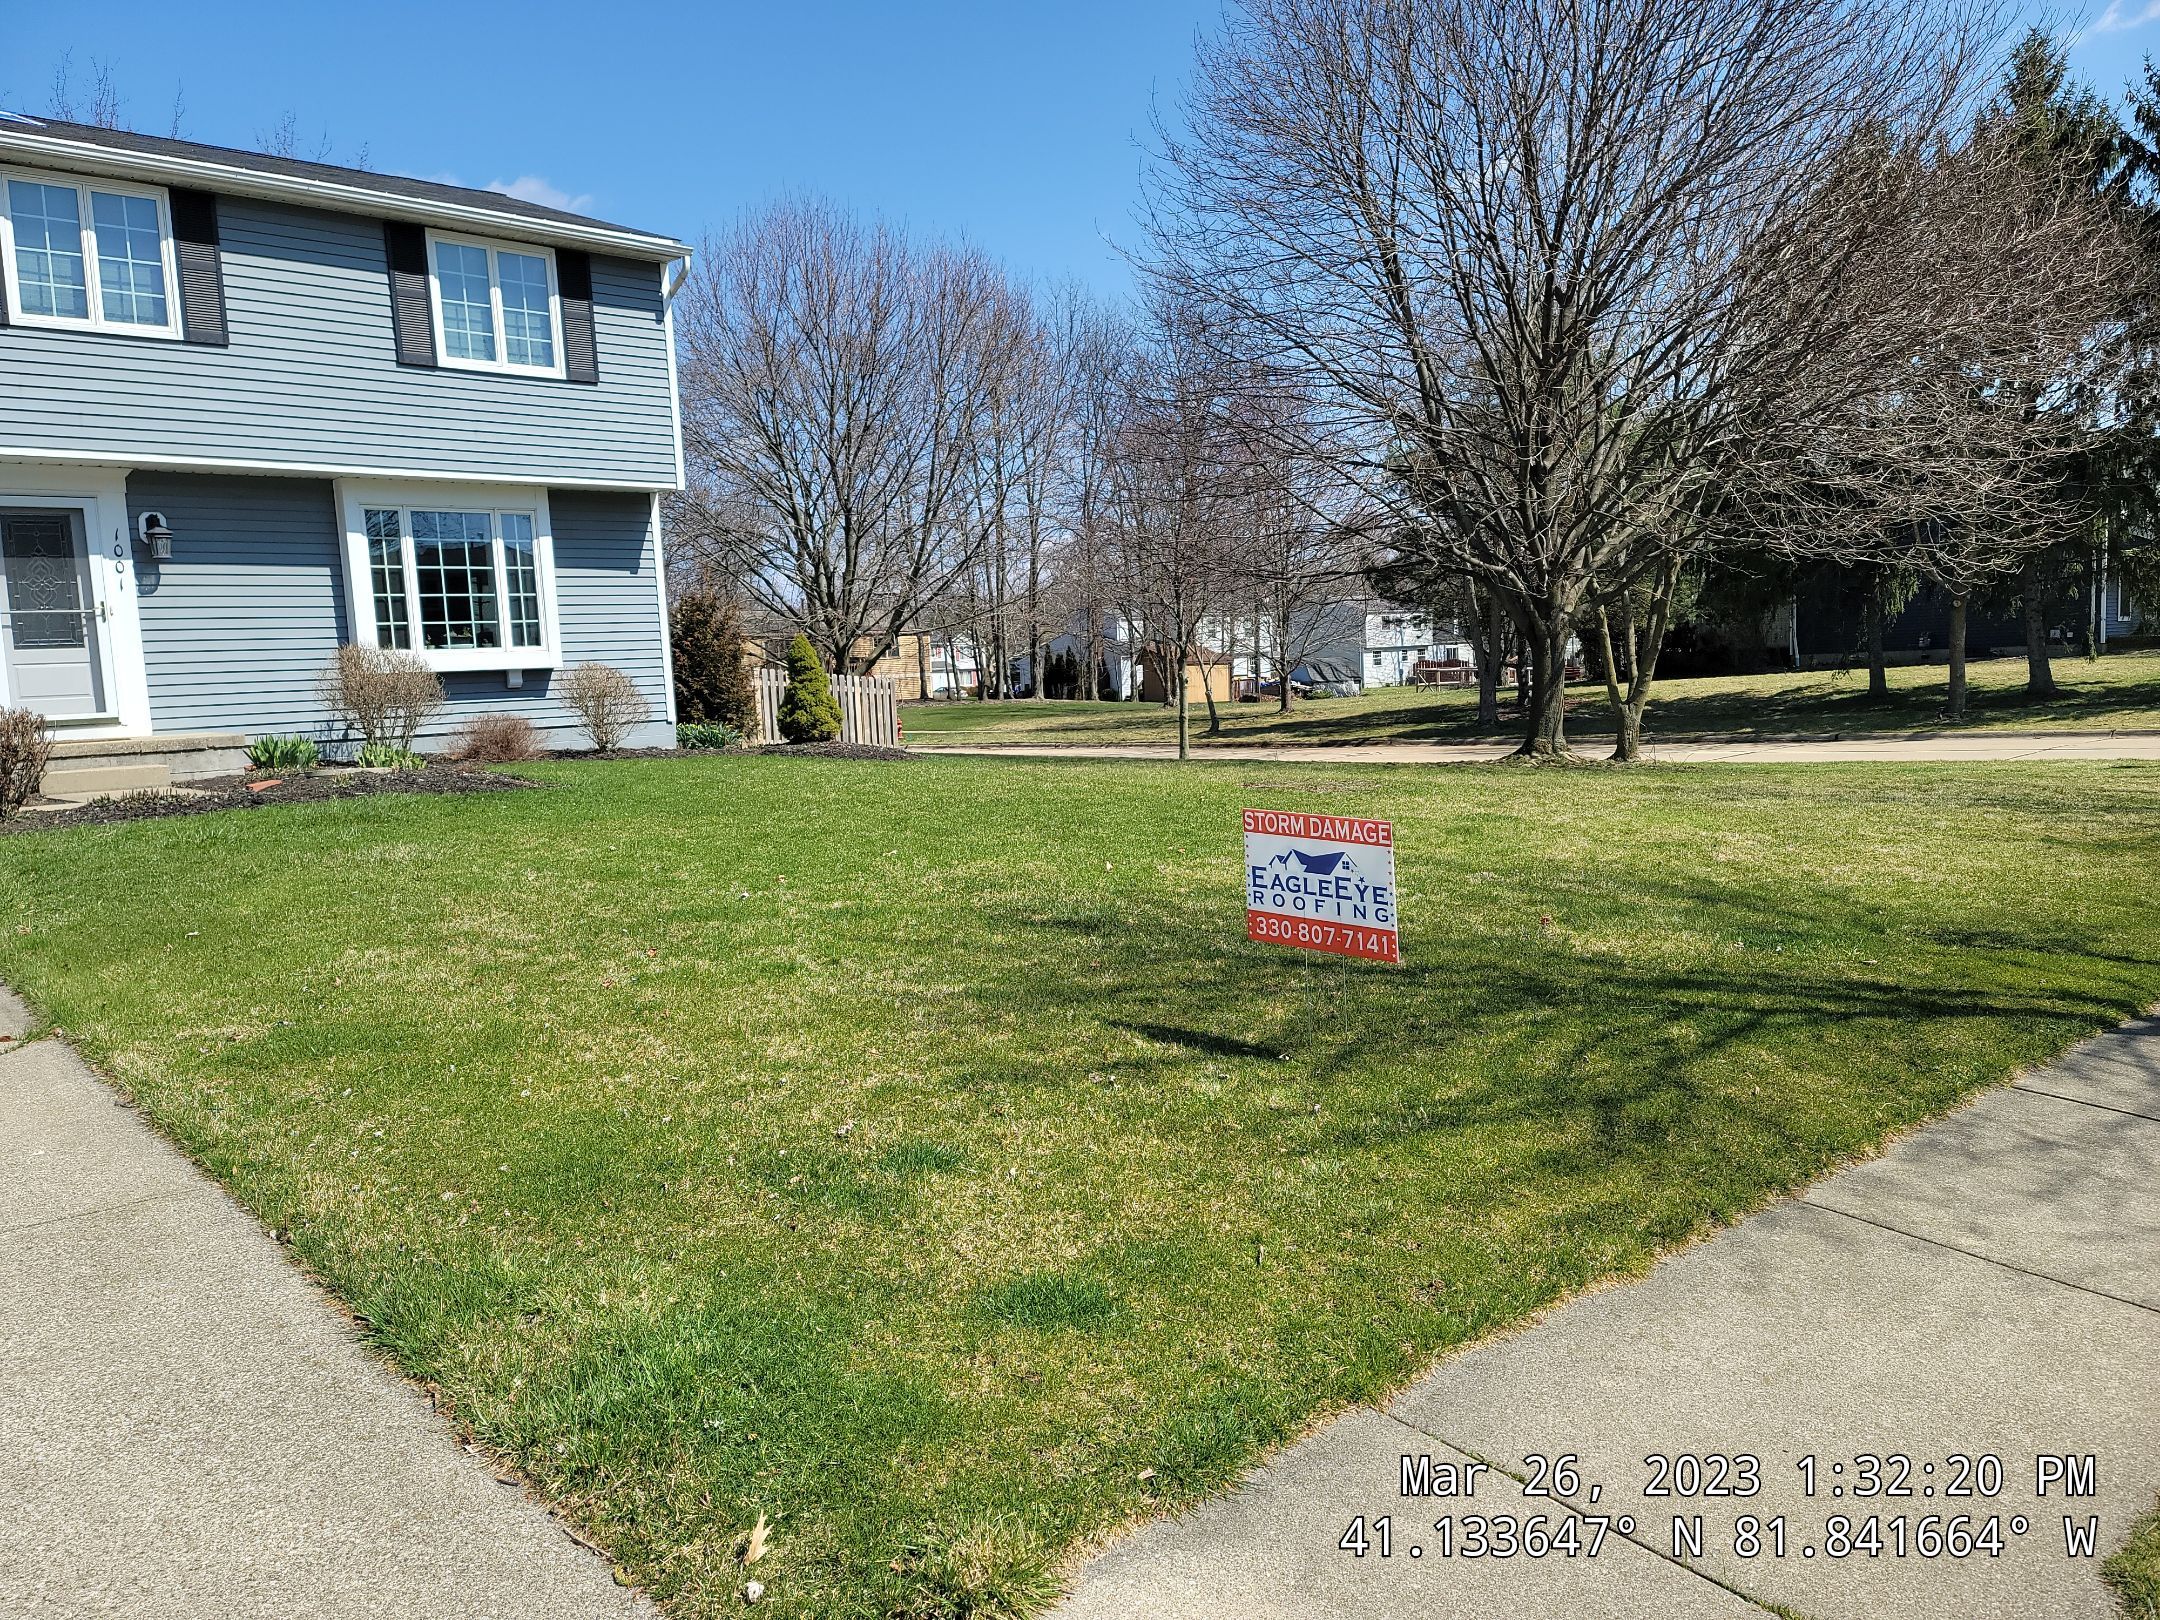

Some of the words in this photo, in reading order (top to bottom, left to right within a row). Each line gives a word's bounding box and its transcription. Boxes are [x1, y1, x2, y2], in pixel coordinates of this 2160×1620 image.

[113, 527, 125, 592] 1001
[1244, 811, 1304, 836] STORM
[1309, 817, 1391, 845] DAMAGE
[1253, 890, 1389, 922] ROOFING
[1256, 916, 1388, 955] 330-807-7141
